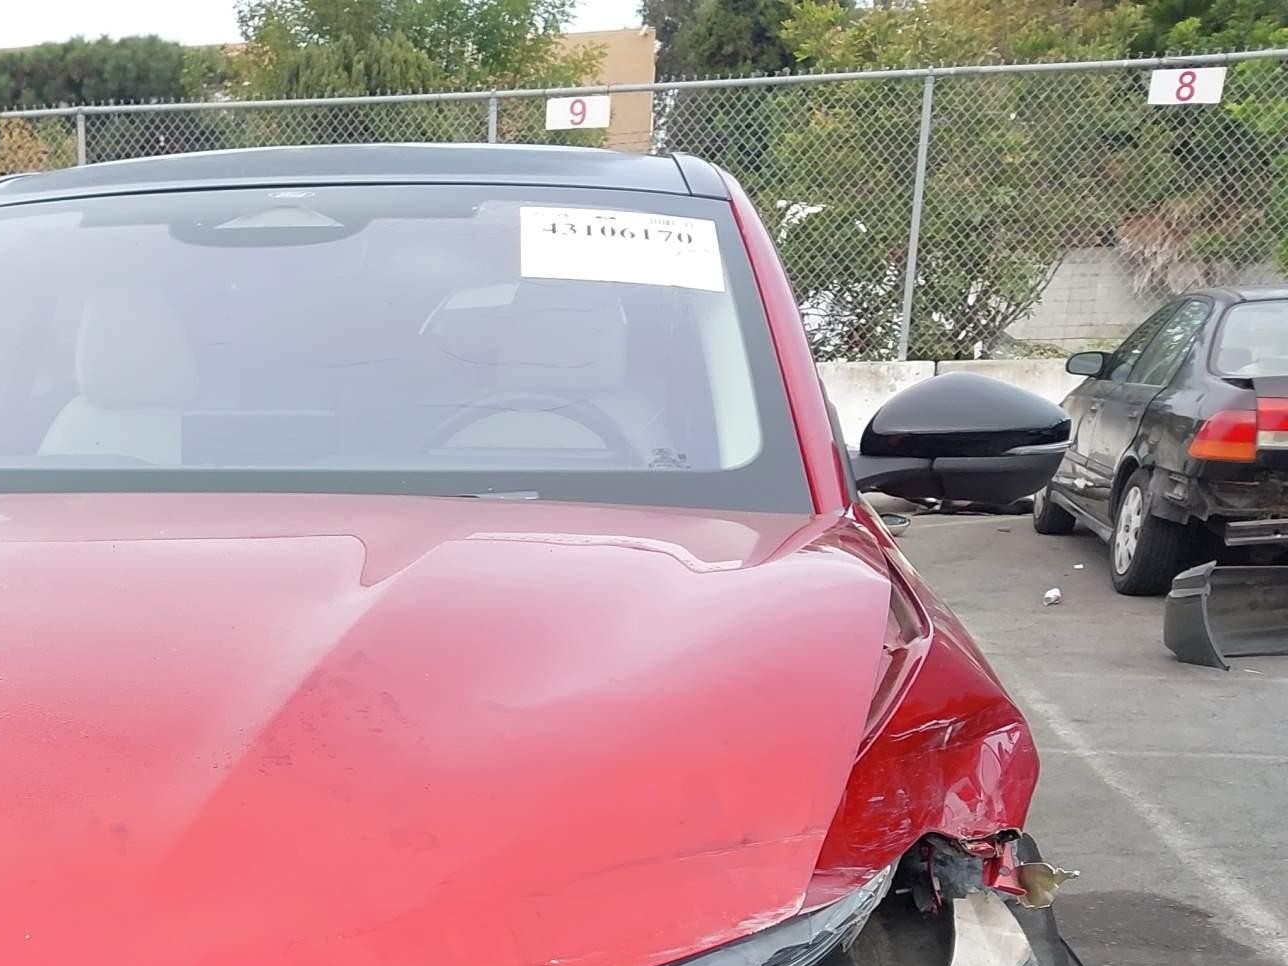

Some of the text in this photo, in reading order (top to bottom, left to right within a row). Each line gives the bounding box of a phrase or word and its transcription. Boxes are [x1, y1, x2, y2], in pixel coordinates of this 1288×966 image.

[1175, 71, 1196, 101] 8
[570, 98, 586, 126] 9
[542, 222, 693, 245] 43106170
